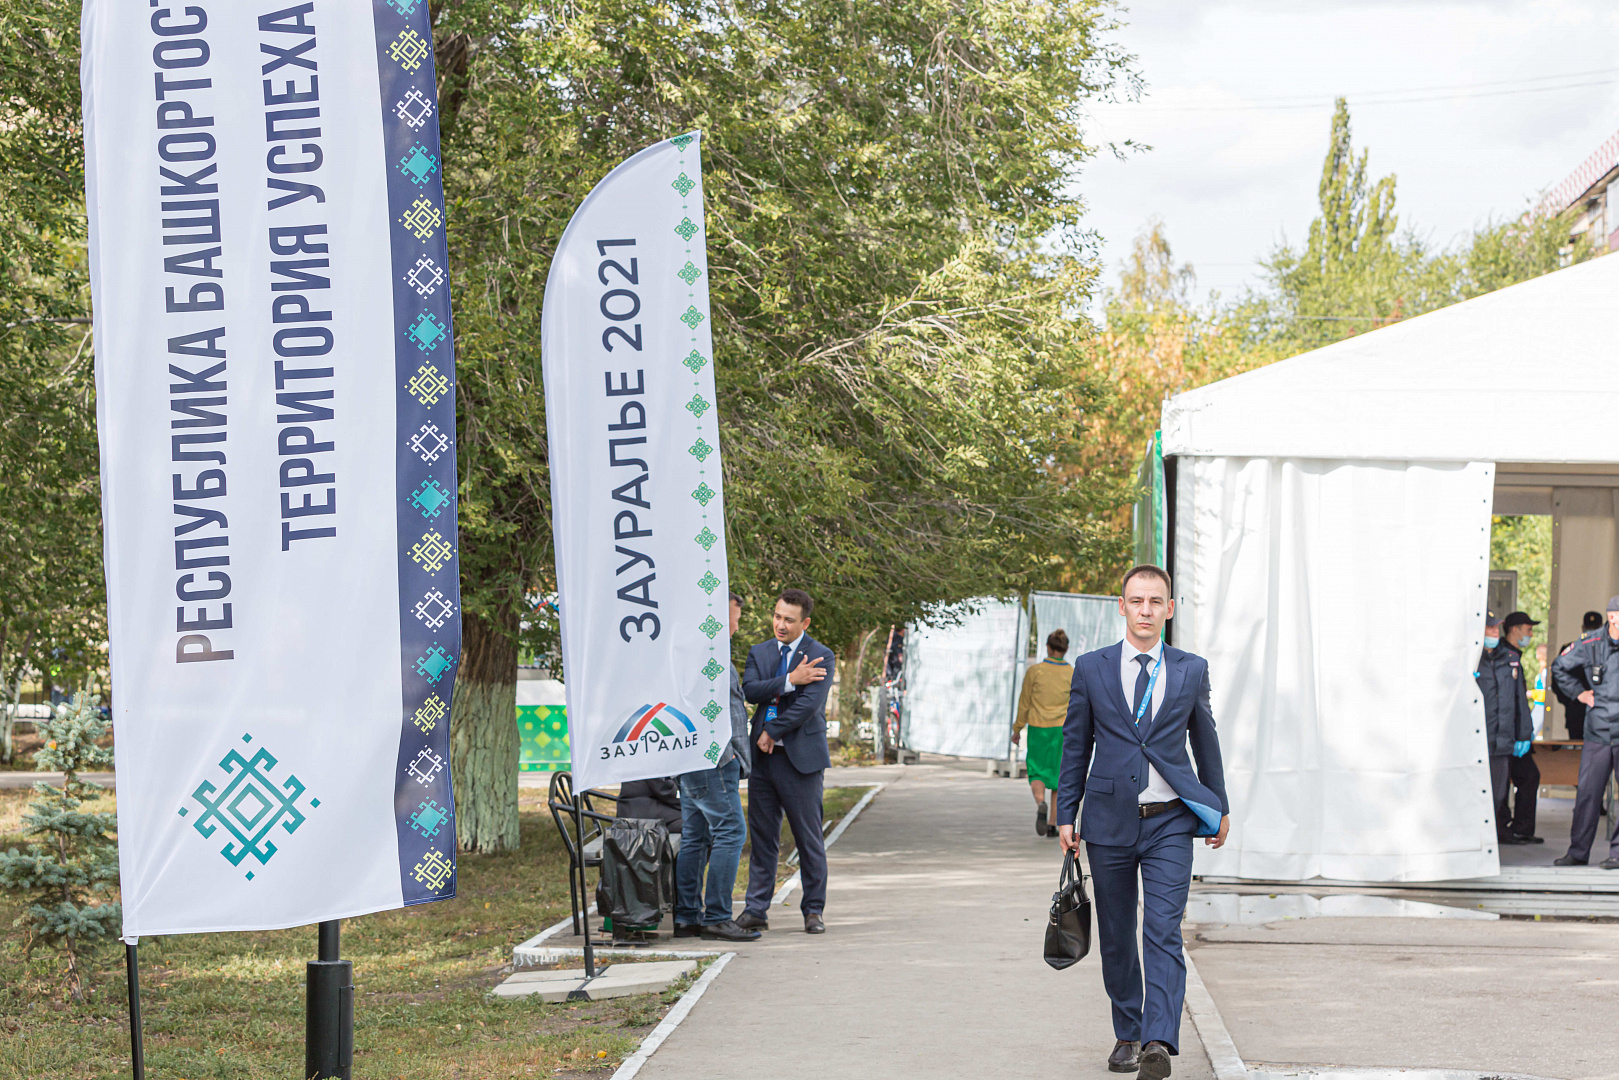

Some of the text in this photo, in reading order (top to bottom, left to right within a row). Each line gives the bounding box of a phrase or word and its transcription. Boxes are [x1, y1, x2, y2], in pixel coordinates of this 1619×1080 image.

[150, 0, 234, 663] РЕСПУБЛИКА БАШКОРТОС
[258, 2, 336, 551] ТЕРРИТОРИЯ УСПЕХА
[597, 239, 661, 643] ЗАУРАЛЬЕ 2021
[600, 730, 698, 760] ЗАУРАЛЬЕ
